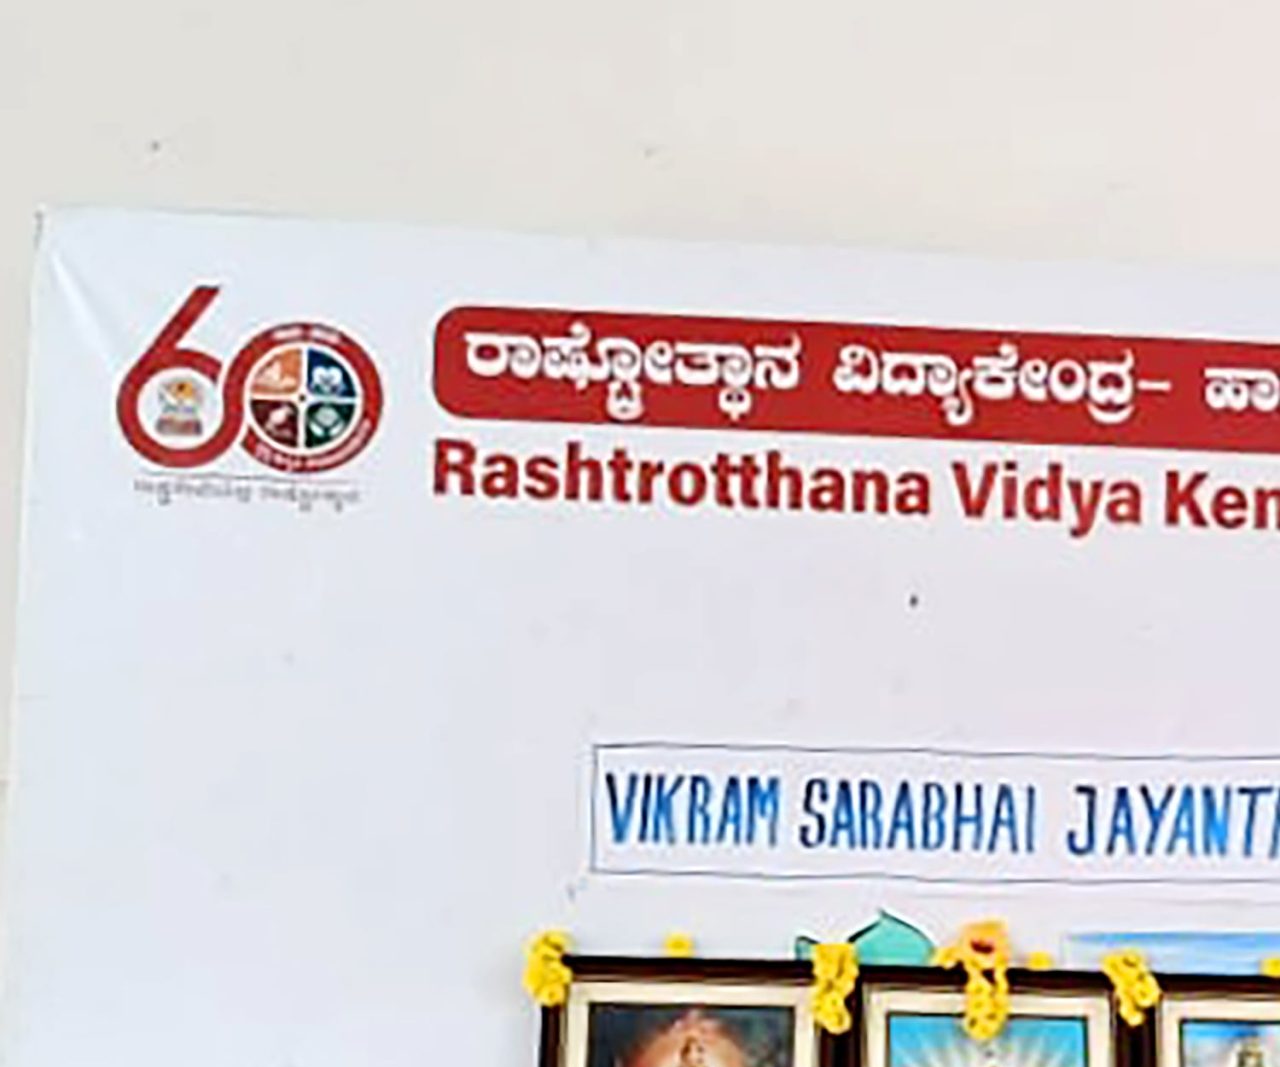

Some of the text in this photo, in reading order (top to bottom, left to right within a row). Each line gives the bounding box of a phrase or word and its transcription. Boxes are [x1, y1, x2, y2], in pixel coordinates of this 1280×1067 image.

[433, 438, 930, 515] Rashtrotthana
[952, 461, 1142, 538] Vidya
[605, 772, 781, 846] VIKRAM
[799, 777, 1037, 854] SARABHAI
